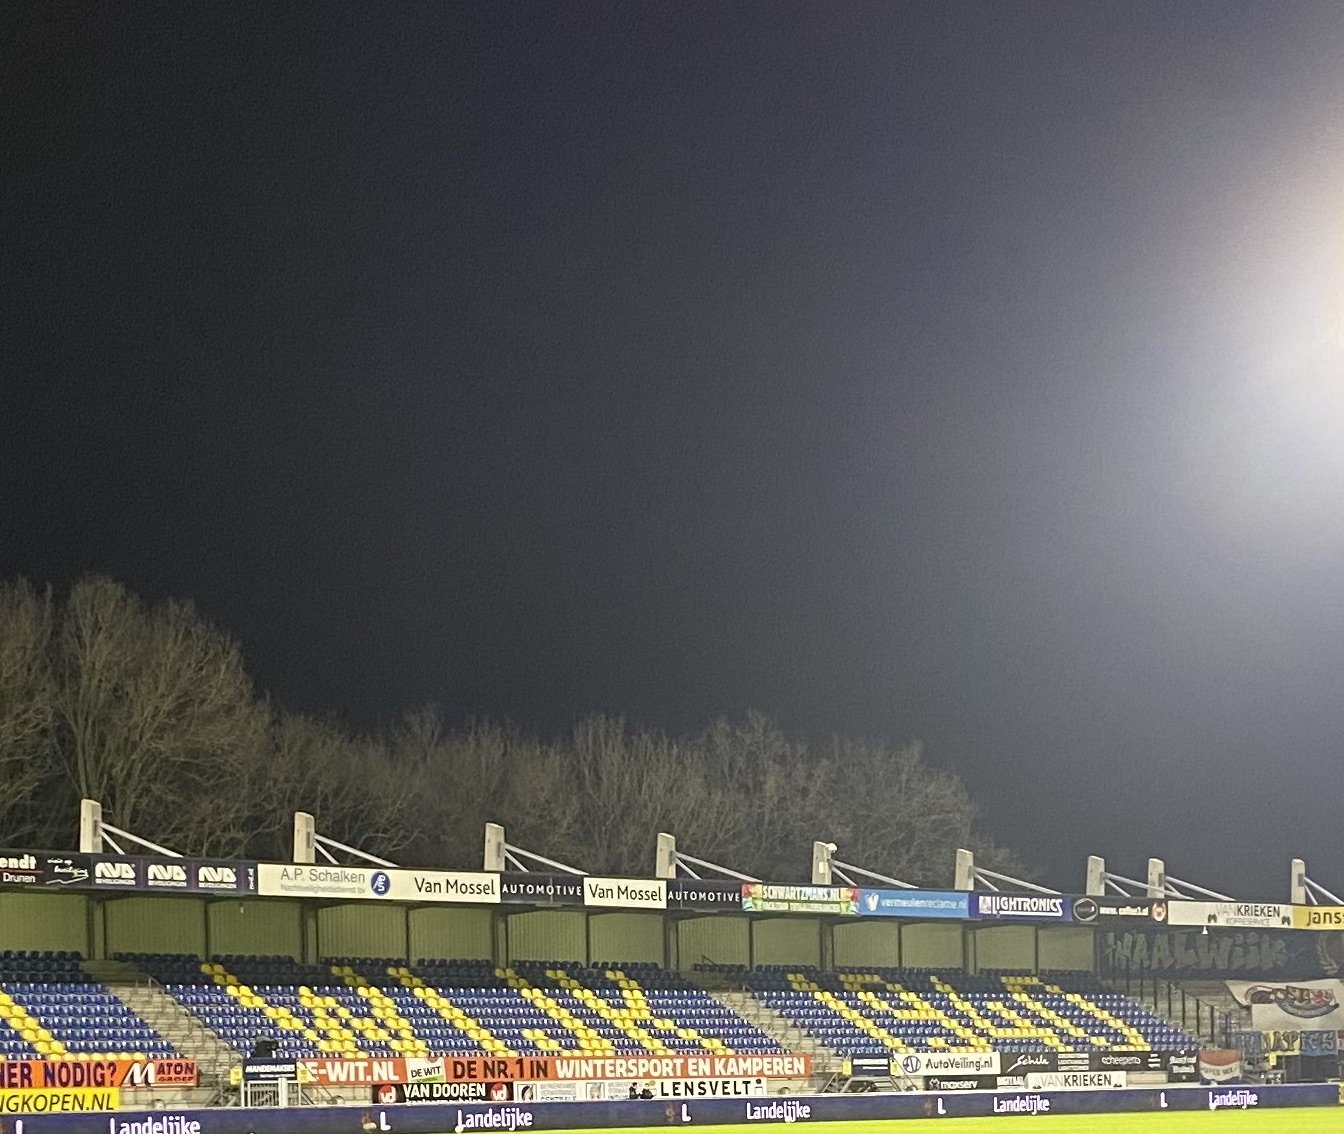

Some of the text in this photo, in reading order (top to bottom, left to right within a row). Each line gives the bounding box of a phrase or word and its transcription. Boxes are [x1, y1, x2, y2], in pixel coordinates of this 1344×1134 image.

[280, 868, 366, 883] A.P. Schalken
[414, 877, 582, 896] Van Mossel AUTOMOTIVE
[588, 884, 740, 902] Van Mossel AUTOMOTIVE
[992, 896, 1063, 916] LIGHTRONICS
[43, 1060, 118, 1089] NODIG?
[411, 1067, 441, 1078] DE WIT
[454, 1061, 477, 1080] DE
[530, 1059, 548, 1078] IN
[556, 1058, 685, 1079] WINTERSPORT
[687, 1058, 710, 1077] EN
[714, 1056, 806, 1076] KAMPEREN
[403, 1083, 486, 1098] VAN DOOREN
[660, 1080, 752, 1097] LENSVELT
[994, 1094, 1050, 1115] Landelijke
[1209, 1089, 1258, 1109] Landelijke
[380, 1111, 391, 1131] L
[457, 1107, 533, 1132] Landelijke
[682, 1104, 692, 1122] L
[746, 1101, 811, 1122] Landelijke
